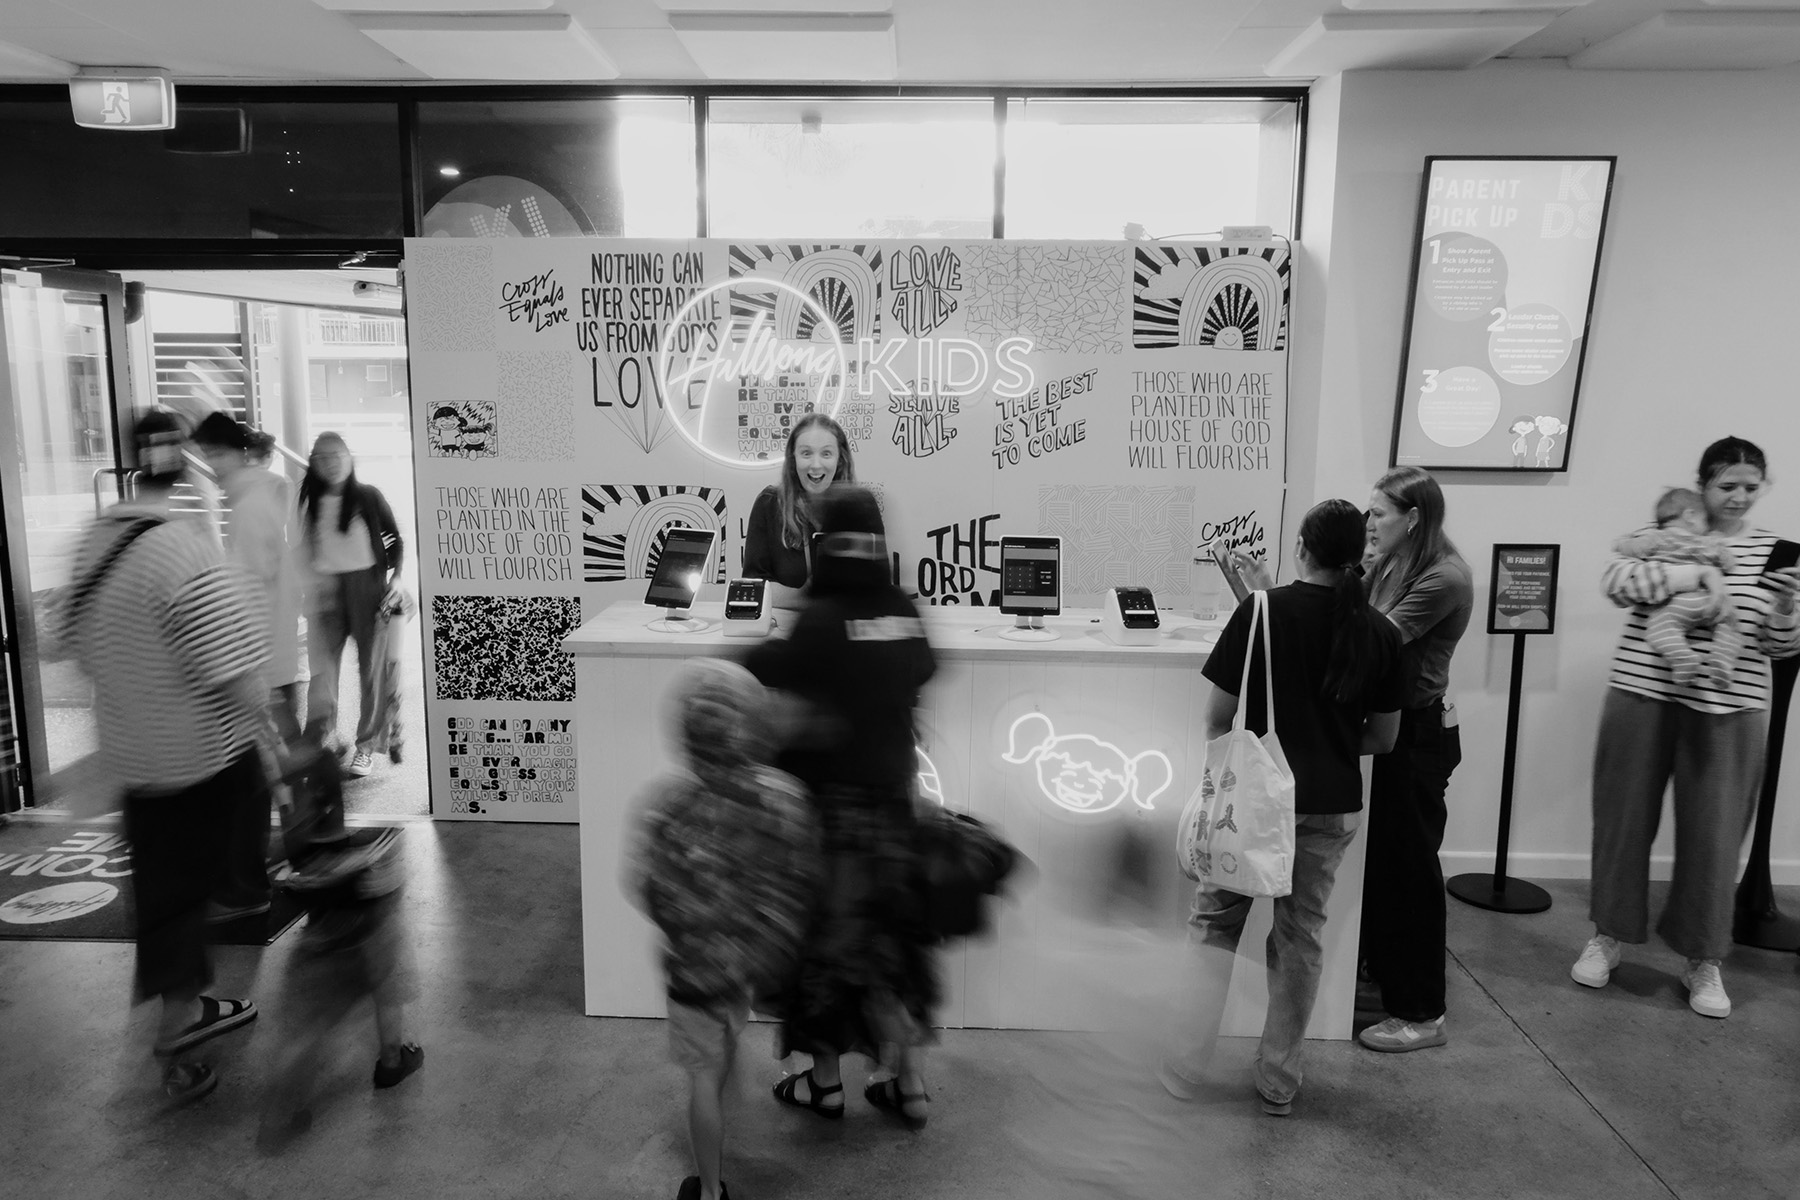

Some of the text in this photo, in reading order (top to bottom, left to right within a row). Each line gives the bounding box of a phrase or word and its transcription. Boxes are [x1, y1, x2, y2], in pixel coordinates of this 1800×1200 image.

[1430, 176, 1521, 200] PARENT
[1428, 205, 1519, 228] PICK UP
[1429, 239, 1441, 265] 1
[1442, 257, 1457, 265] Pick
[1458, 258, 1469, 266] Up
[1447, 247, 1467, 255] Show
[591, 251, 703, 285] NOTHING CAN
[889, 245, 962, 291] LOVE
[1442, 267, 1461, 275] Entry
[501, 268, 554, 302] Cross
[498, 280, 564, 323] Equals
[581, 286, 722, 322] EVER SEPARATE
[535, 306, 570, 333] Love
[1487, 307, 1507, 332] 2
[576, 321, 718, 353] US FROM GOD'S
[592, 355, 708, 410] LOVE
[668, 309, 1035, 443] Hillsong KIDS
[1131, 371, 1273, 396] THOSE WHO ARE
[1420, 369, 1440, 393] 3
[737, 388, 759, 402] RE
[763, 388, 809, 402] THAN
[995, 368, 1099, 421] THE BEST
[738, 401, 770, 414] ULD
[773, 401, 815, 414] EVER
[1131, 395, 1272, 420] PLANTED IN THE
[738, 414, 749, 427] E
[752, 414, 777, 427] OR
[863, 415, 874, 428] R
[995, 403, 1062, 447] IS YET
[1130, 419, 1272, 445] HOUSE OF GOD
[737, 427, 791, 440] EQUES
[991, 418, 1087, 470] TO COME
[1128, 444, 1167, 470] WILL
[434, 486, 570, 510] THOSE WHO ARE
[436, 509, 571, 533] PLANTED IN THE
[1201, 509, 1256, 542] Cross
[437, 532, 573, 557] HOUSE OF GOD
[926, 513, 1001, 574] THE
[438, 556, 476, 580] WILL
[1506, 555, 1547, 565] HI FAMILIES!
[447, 717, 572, 733] GOD CAN DO ANY
[448, 744, 574, 757] RE THAN YOU CO
[514, 732, 546, 744] FAR
[548, 732, 573, 745] MO
[449, 756, 577, 769] ULD EVER IMAGIN
[449, 767, 576, 781] E OR GUESS OR R
[450, 779, 576, 793] EQUEST IN YOUR
[450, 789, 564, 804] WILDEST DREA
[450, 801, 487, 814] MS.
